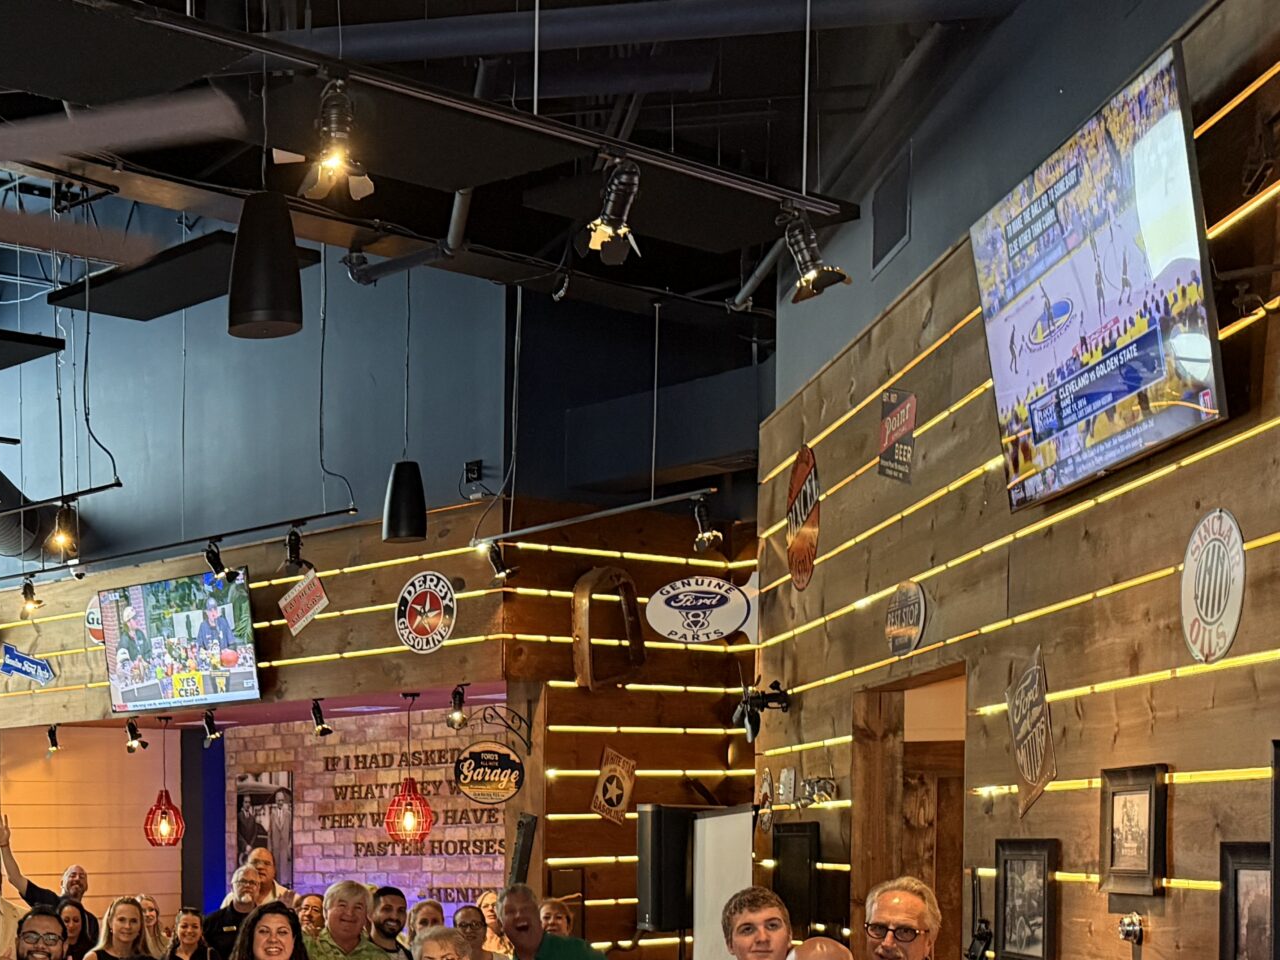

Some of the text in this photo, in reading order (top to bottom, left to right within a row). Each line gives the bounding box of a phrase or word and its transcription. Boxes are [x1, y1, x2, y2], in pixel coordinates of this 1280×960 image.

[1095, 357, 1119, 378] GOLDEN
[1119, 343, 1138, 365] STATE
[895, 443, 912, 462] BEER
[1190, 514, 1241, 573] SINCLAIR
[403, 575, 454, 608] DERBY
[659, 578, 736, 596] GENUINE
[670, 592, 721, 607] Ford
[398, 617, 448, 650] GASOLINE
[667, 629, 724, 641] PARTS
[1189, 617, 1227, 659] OILS
[179, 676, 197, 687] YES
[323, 755, 341, 772] IF
[344, 755, 350, 770] I
[354, 752, 394, 770] HAD
[460, 759, 520, 789] Garage
[333, 784, 390, 801] WHAT
[391, 780, 446, 798] TEY
[318, 813, 367, 830] THEY
[442, 808, 499, 826] HAVE
[353, 840, 427, 858] FASTER
